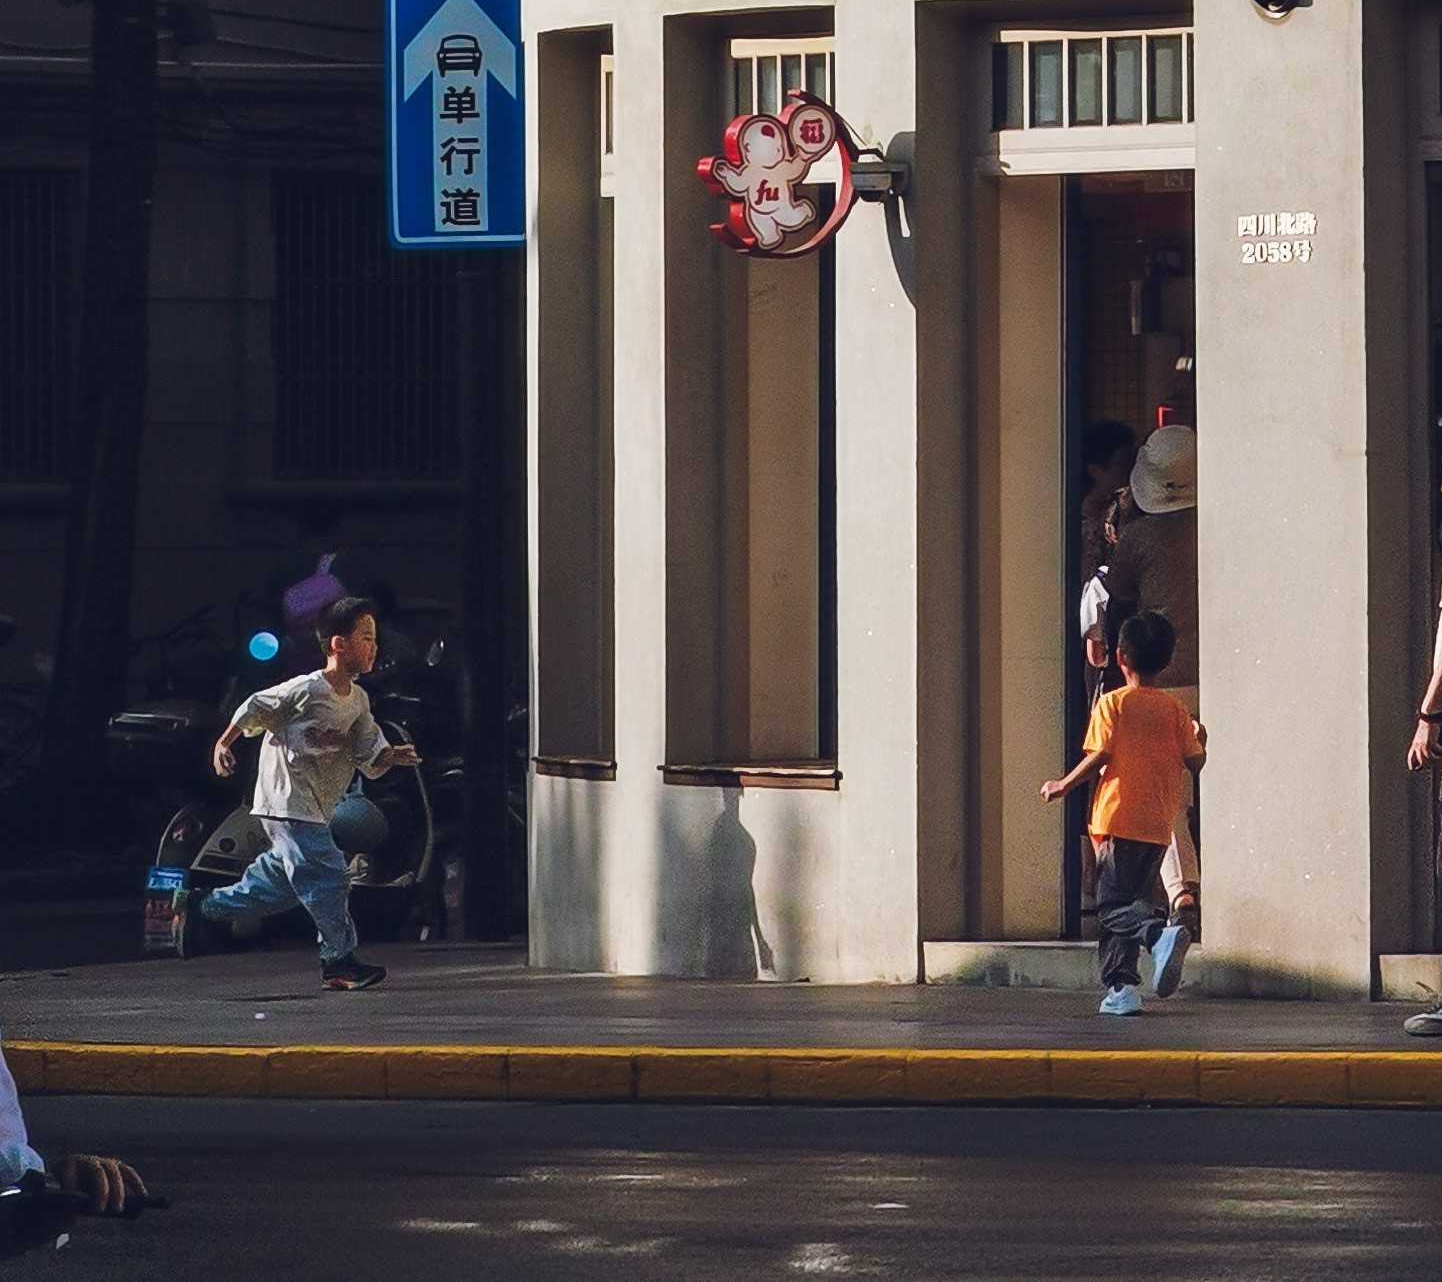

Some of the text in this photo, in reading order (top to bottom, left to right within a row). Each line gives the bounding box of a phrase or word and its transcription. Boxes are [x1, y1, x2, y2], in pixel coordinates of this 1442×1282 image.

[439, 86, 481, 226] 单行道
[755, 179, 779, 205] fu
[1237, 211, 1318, 237] 四川北路
[1241, 239, 1312, 264] 2058号
